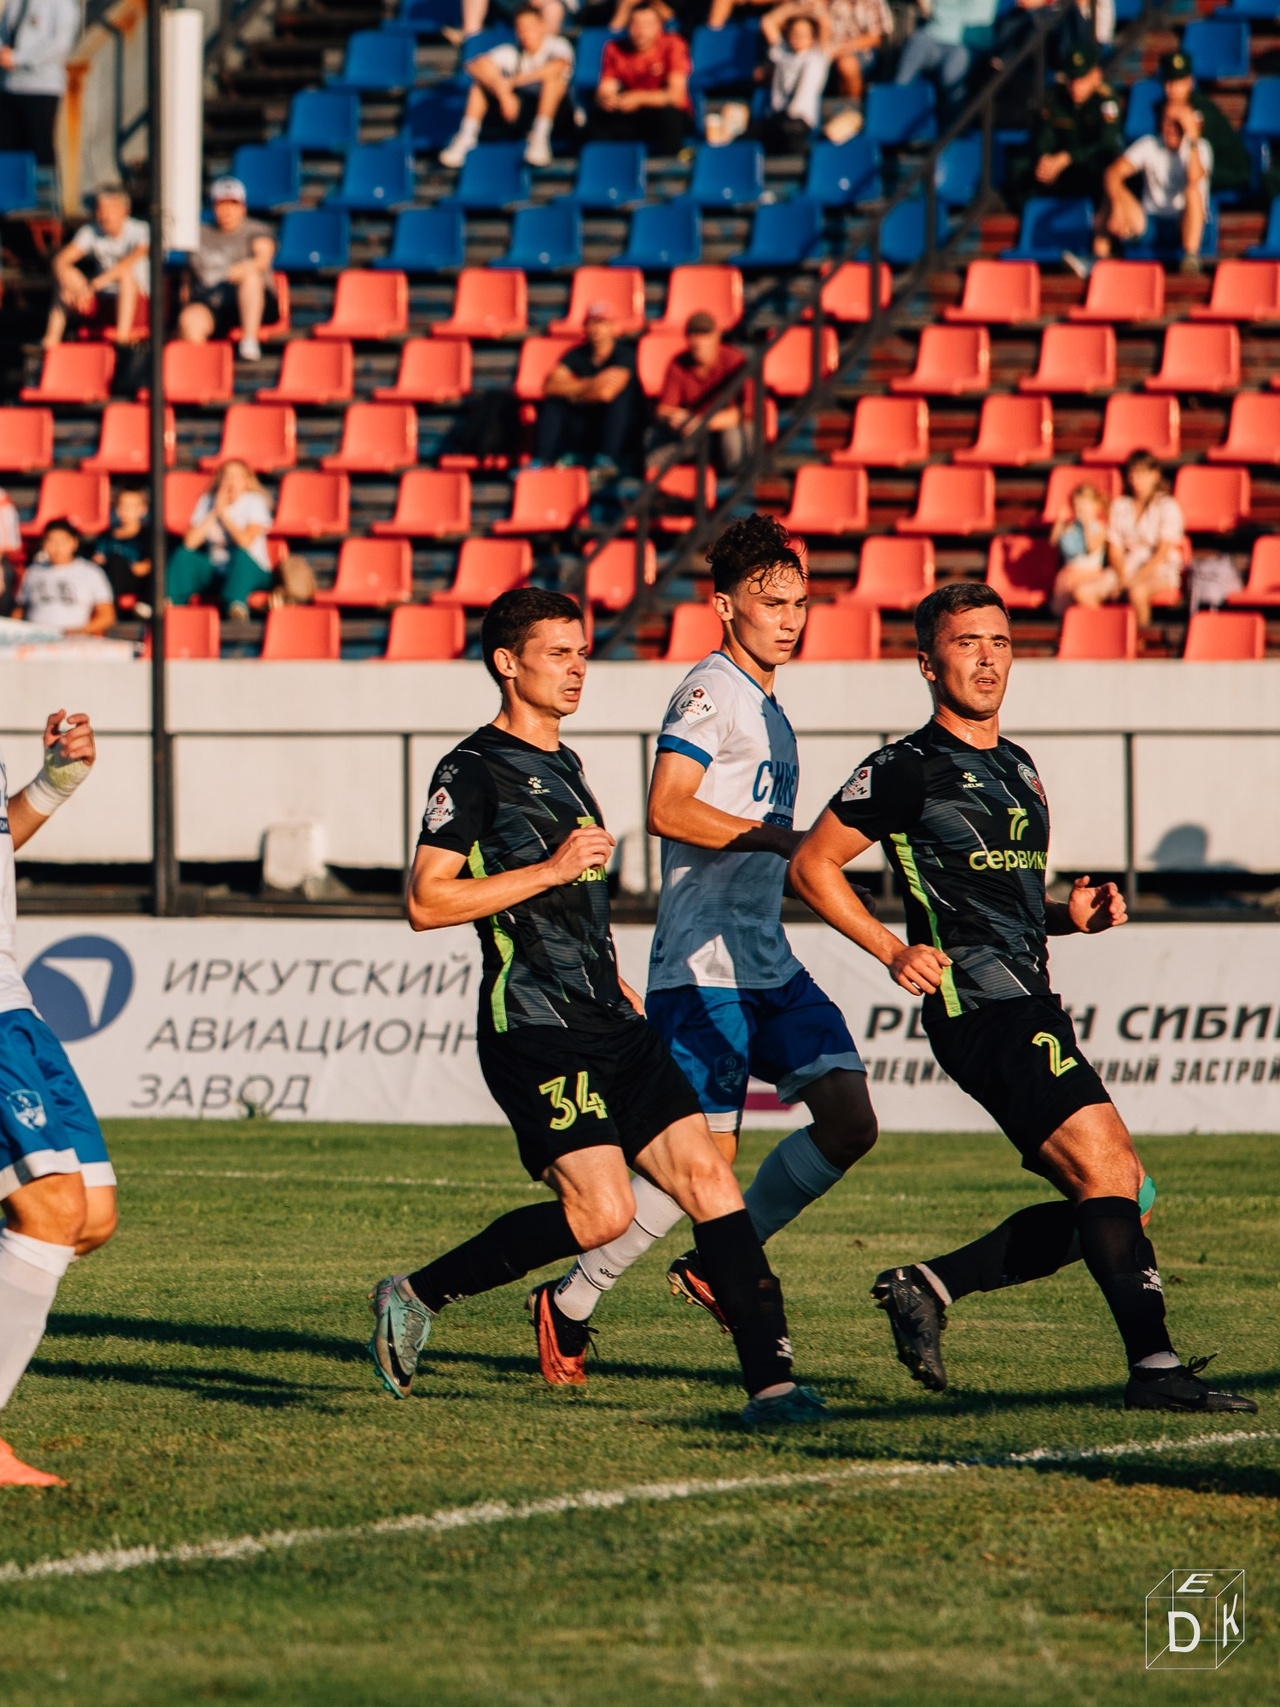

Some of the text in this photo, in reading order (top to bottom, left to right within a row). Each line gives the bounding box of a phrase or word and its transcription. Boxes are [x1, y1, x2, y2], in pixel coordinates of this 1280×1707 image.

[969, 849, 1049, 872] сервик
[164, 953, 472, 997] ИРКУТСКИЙ
[145, 1018, 477, 1056] АВИАЦИОНН
[1118, 1004, 1280, 1041] СИБИ
[1032, 1031, 1078, 1077] 2
[130, 1075, 312, 1115] ЗАВОД
[538, 1071, 608, 1130] 34
